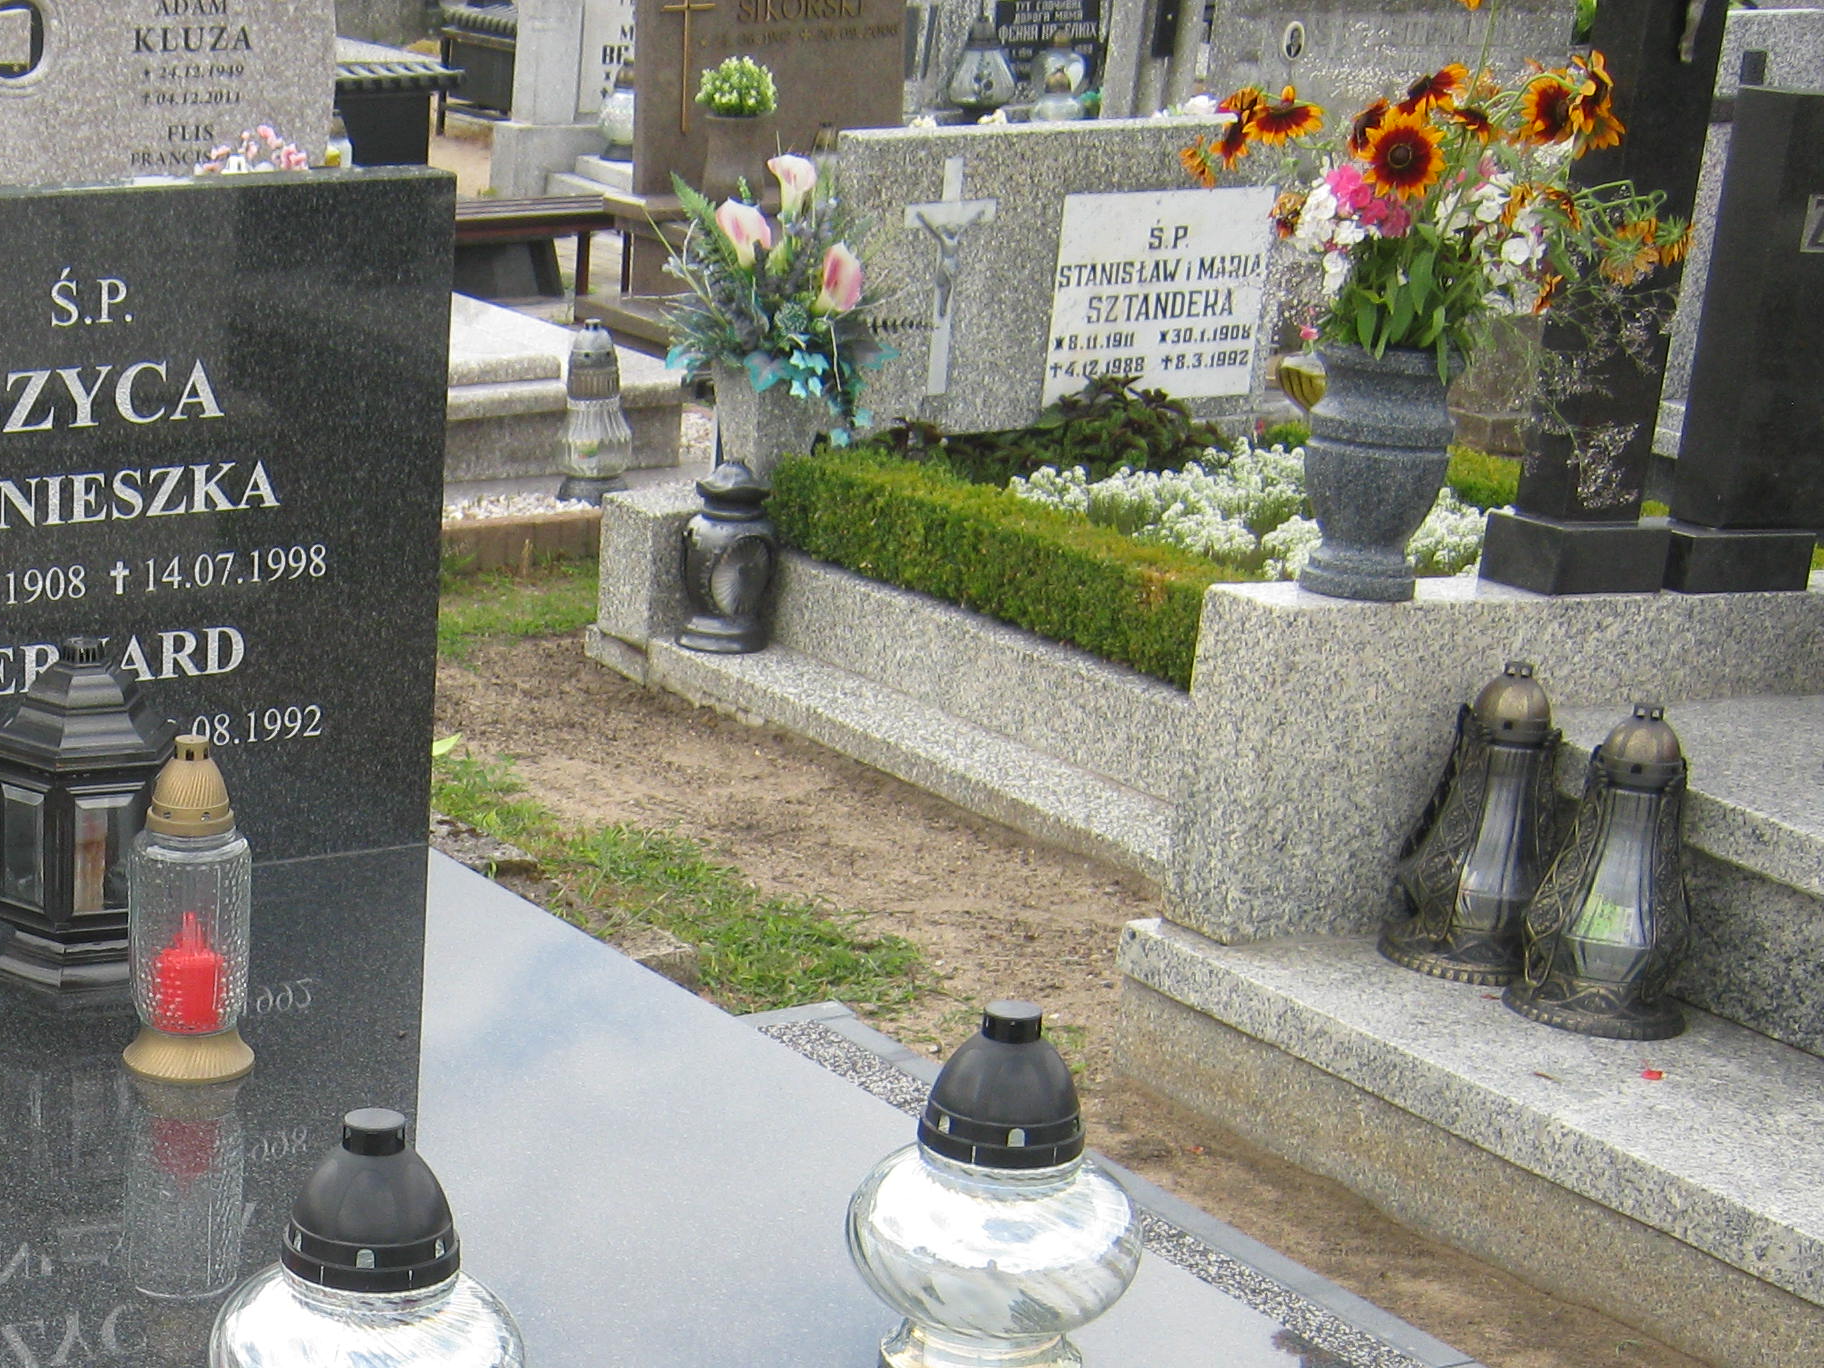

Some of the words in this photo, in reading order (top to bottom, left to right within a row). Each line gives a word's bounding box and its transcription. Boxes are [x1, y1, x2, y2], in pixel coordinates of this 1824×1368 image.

[155, 0, 227, 16] ADAM
[737, 0, 863, 23] SIKORSKI
[133, 24, 253, 53] KLUZA
[167, 124, 214, 142] FLIS
[131, 150, 212, 167] FRANCIS
[1058, 258, 1181, 289] STANISŁAW
[1197, 253, 1262, 281] MARIA
[51, 268, 133, 328] Ś.P.
[1175, 349, 1249, 370] 8.3.1992
[145, 543, 328, 592] 14.07.1998
[188, 704, 323, 748] 08.1992
